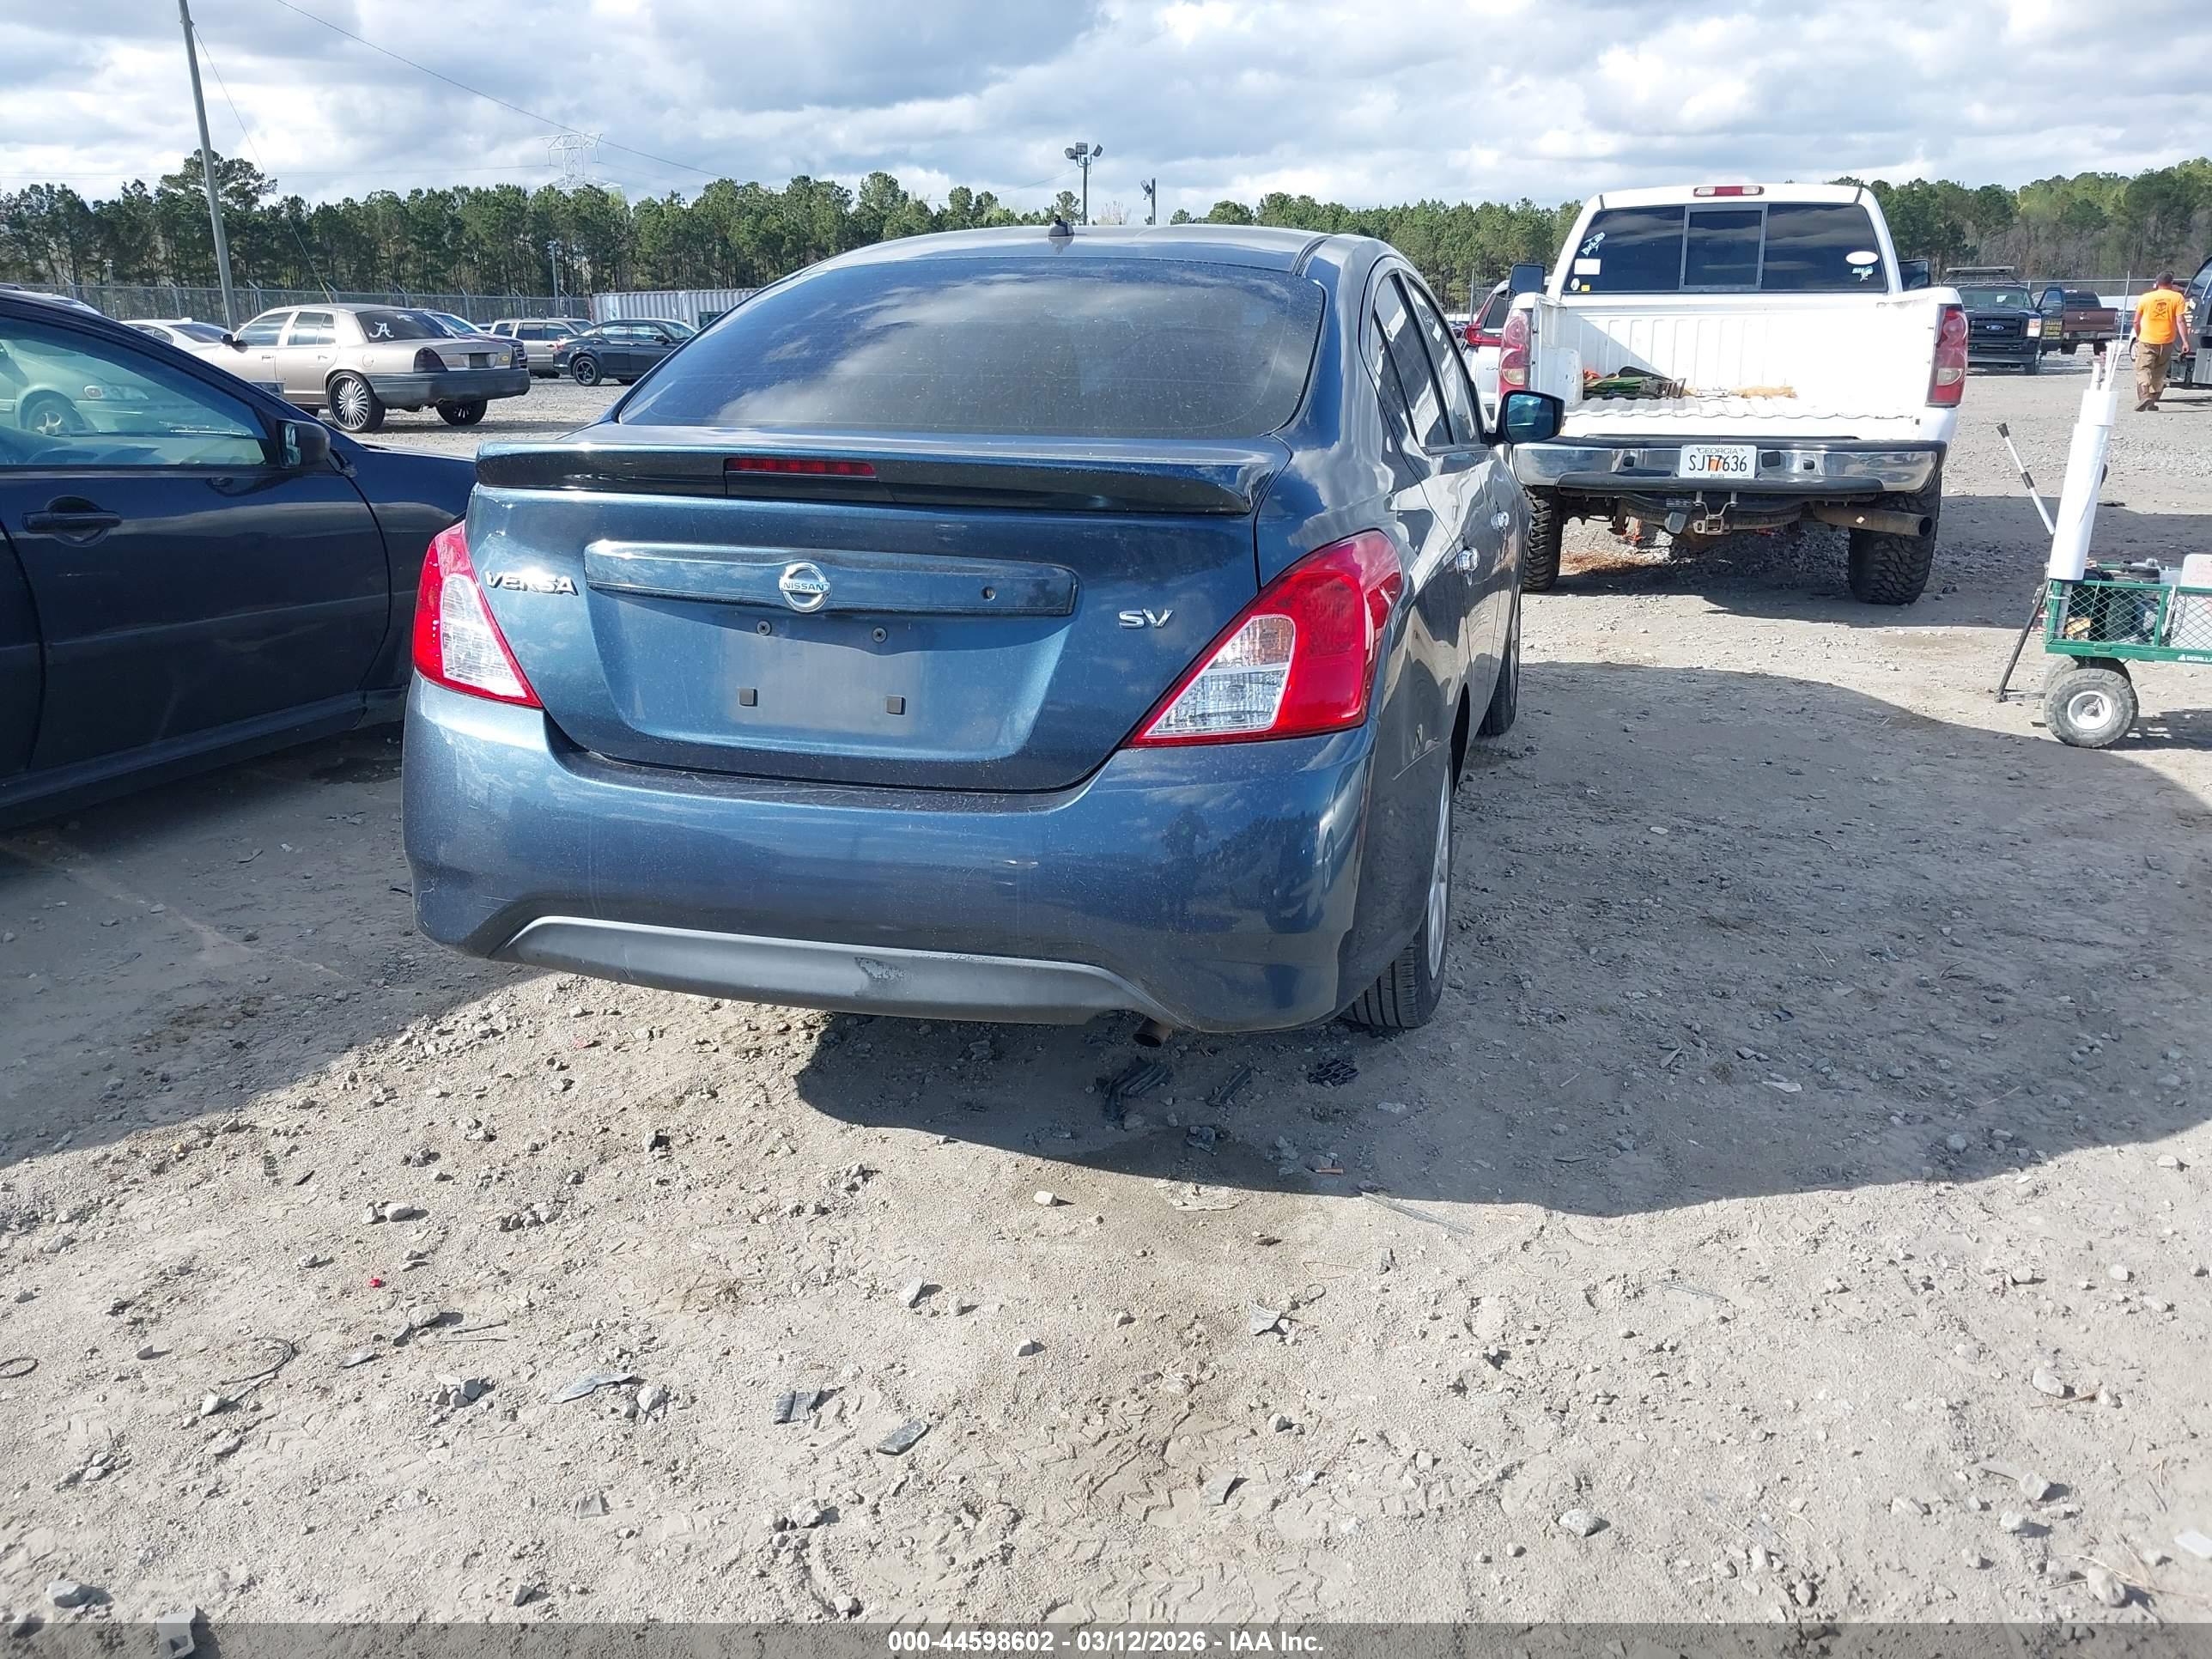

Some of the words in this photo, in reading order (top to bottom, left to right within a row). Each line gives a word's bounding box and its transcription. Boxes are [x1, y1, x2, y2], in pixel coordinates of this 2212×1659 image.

[1688, 454, 1747, 472] SJT7636
[783, 582, 824, 591] NISSAN
[1119, 609, 1174, 629] SV
